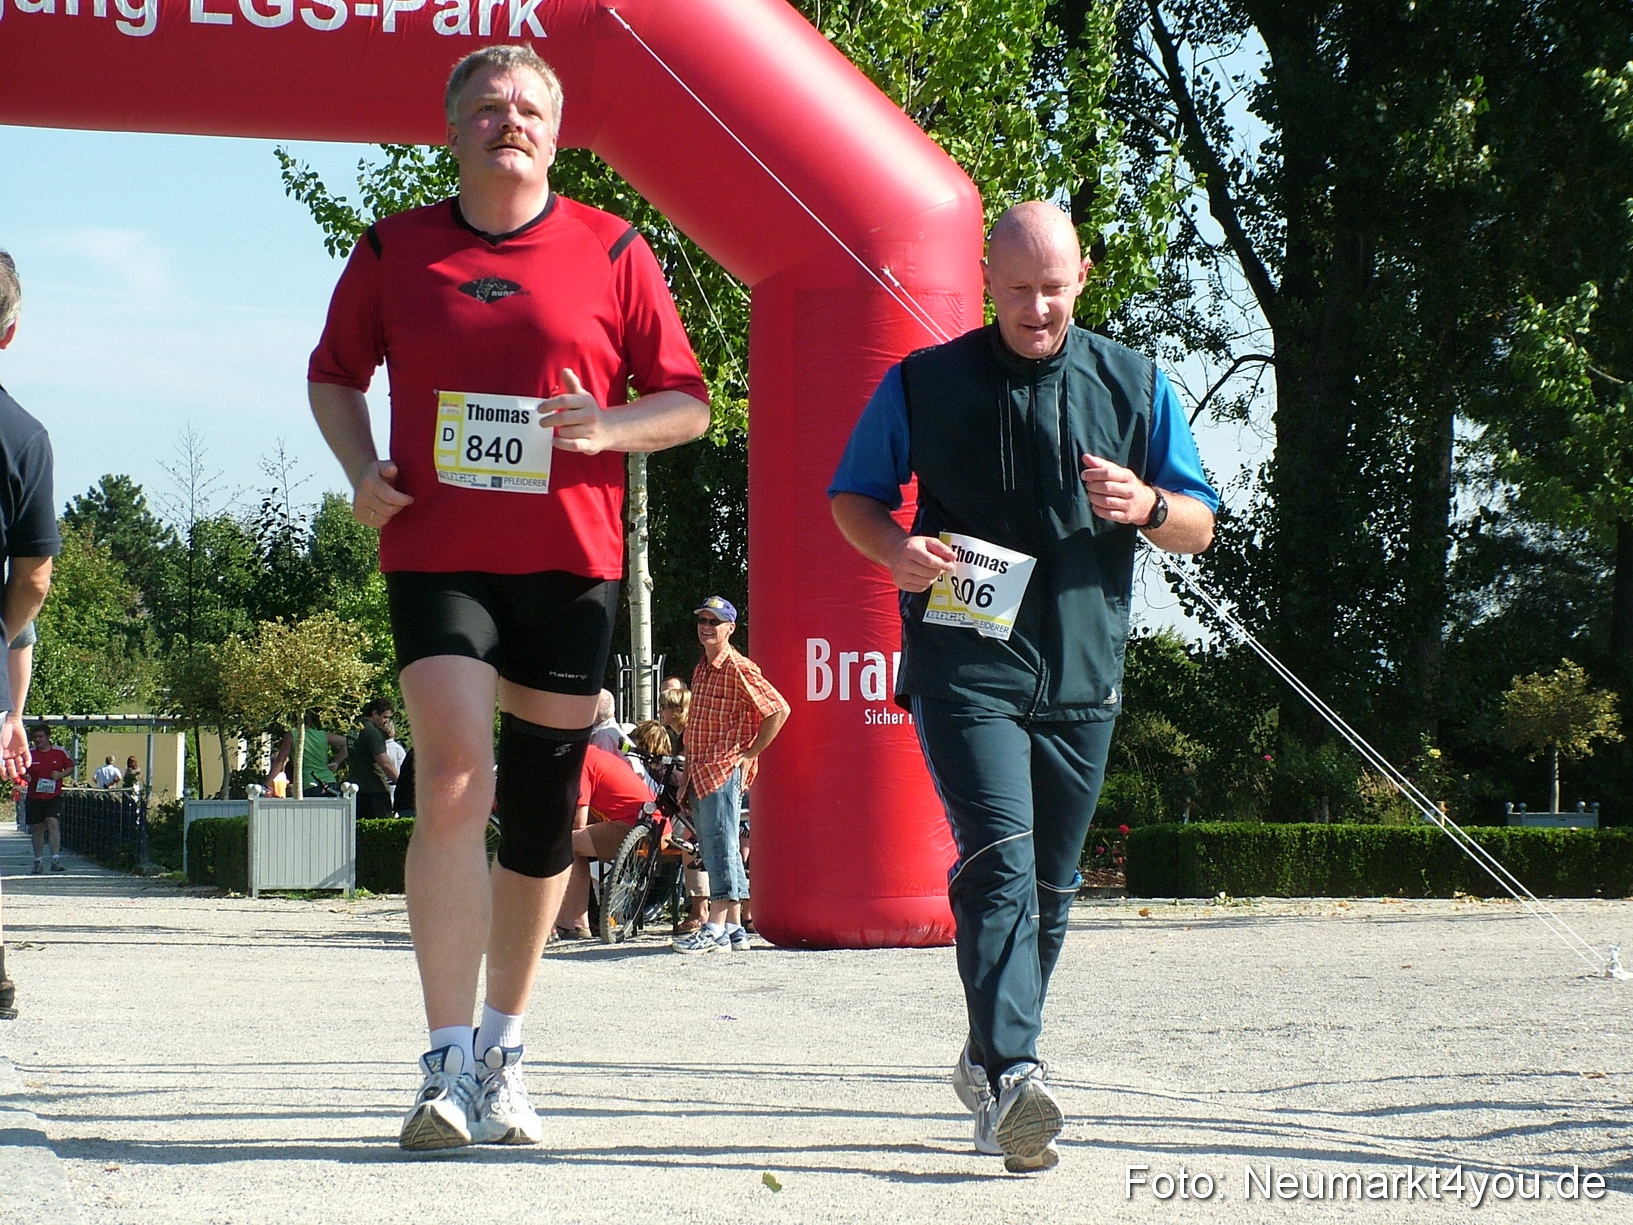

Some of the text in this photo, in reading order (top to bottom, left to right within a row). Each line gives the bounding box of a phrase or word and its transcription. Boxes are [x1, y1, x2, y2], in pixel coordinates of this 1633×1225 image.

[466, 403, 530, 424] Thomas
[442, 427, 455, 442] D
[466, 435, 523, 465] 840
[503, 476, 547, 487] PFLEIDERER
[950, 575, 996, 608] 806
[926, 611, 965, 621] BOCK
[864, 707, 905, 725] Sicher
